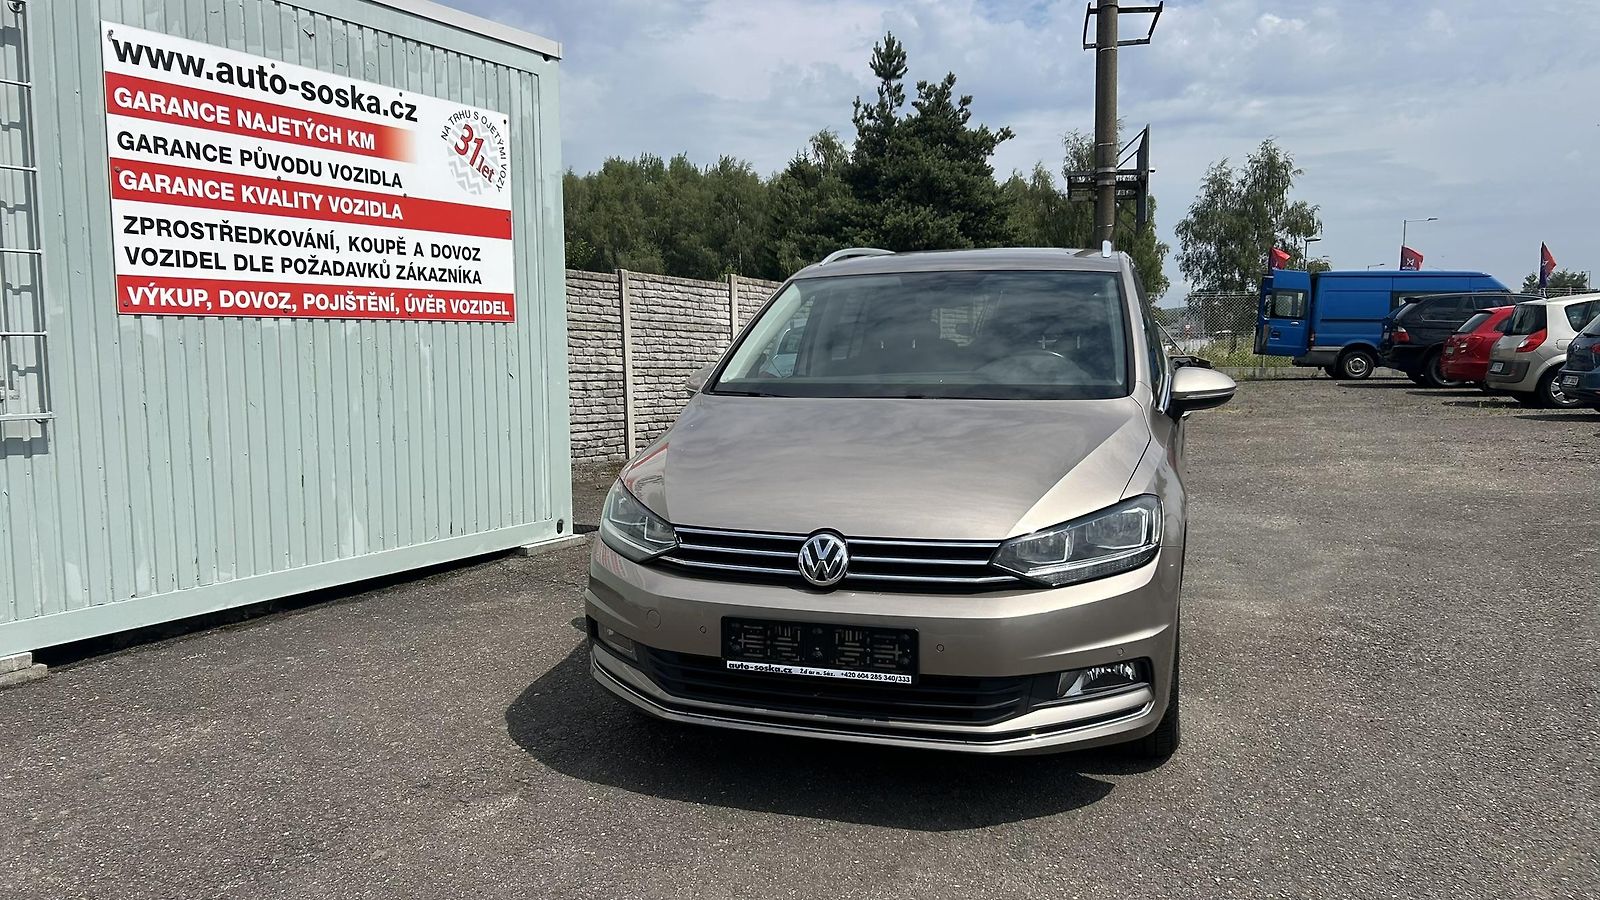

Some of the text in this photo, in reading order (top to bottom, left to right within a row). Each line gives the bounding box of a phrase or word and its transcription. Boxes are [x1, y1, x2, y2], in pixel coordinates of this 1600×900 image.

[112, 39, 418, 122] www.auto-soska.cz
[113, 87, 375, 150] GARANCE NAJETÝCH KM
[117, 131, 403, 188] GARANCE PŮVODU VOZIDLA
[441, 109, 507, 192] NA TRHU S OJETÝMI VOZY
[454, 123, 484, 167] 31
[119, 170, 403, 220] GARANCE KVALITY VOZIDLA
[123, 215, 482, 262] ZPROSTŘEDKOVÁNÍ, KOUPĚ A DOVOZ
[124, 246, 482, 285] VOZIDEL DLE POŽADAVKŮ ZÁKAZNÍKA
[127, 282, 509, 316] VÝKUP, DOVOZ, POJIŠTĚNÍ, ÚVĚR VOZIDEL
[728, 662, 793, 674] auto-soska.cz
